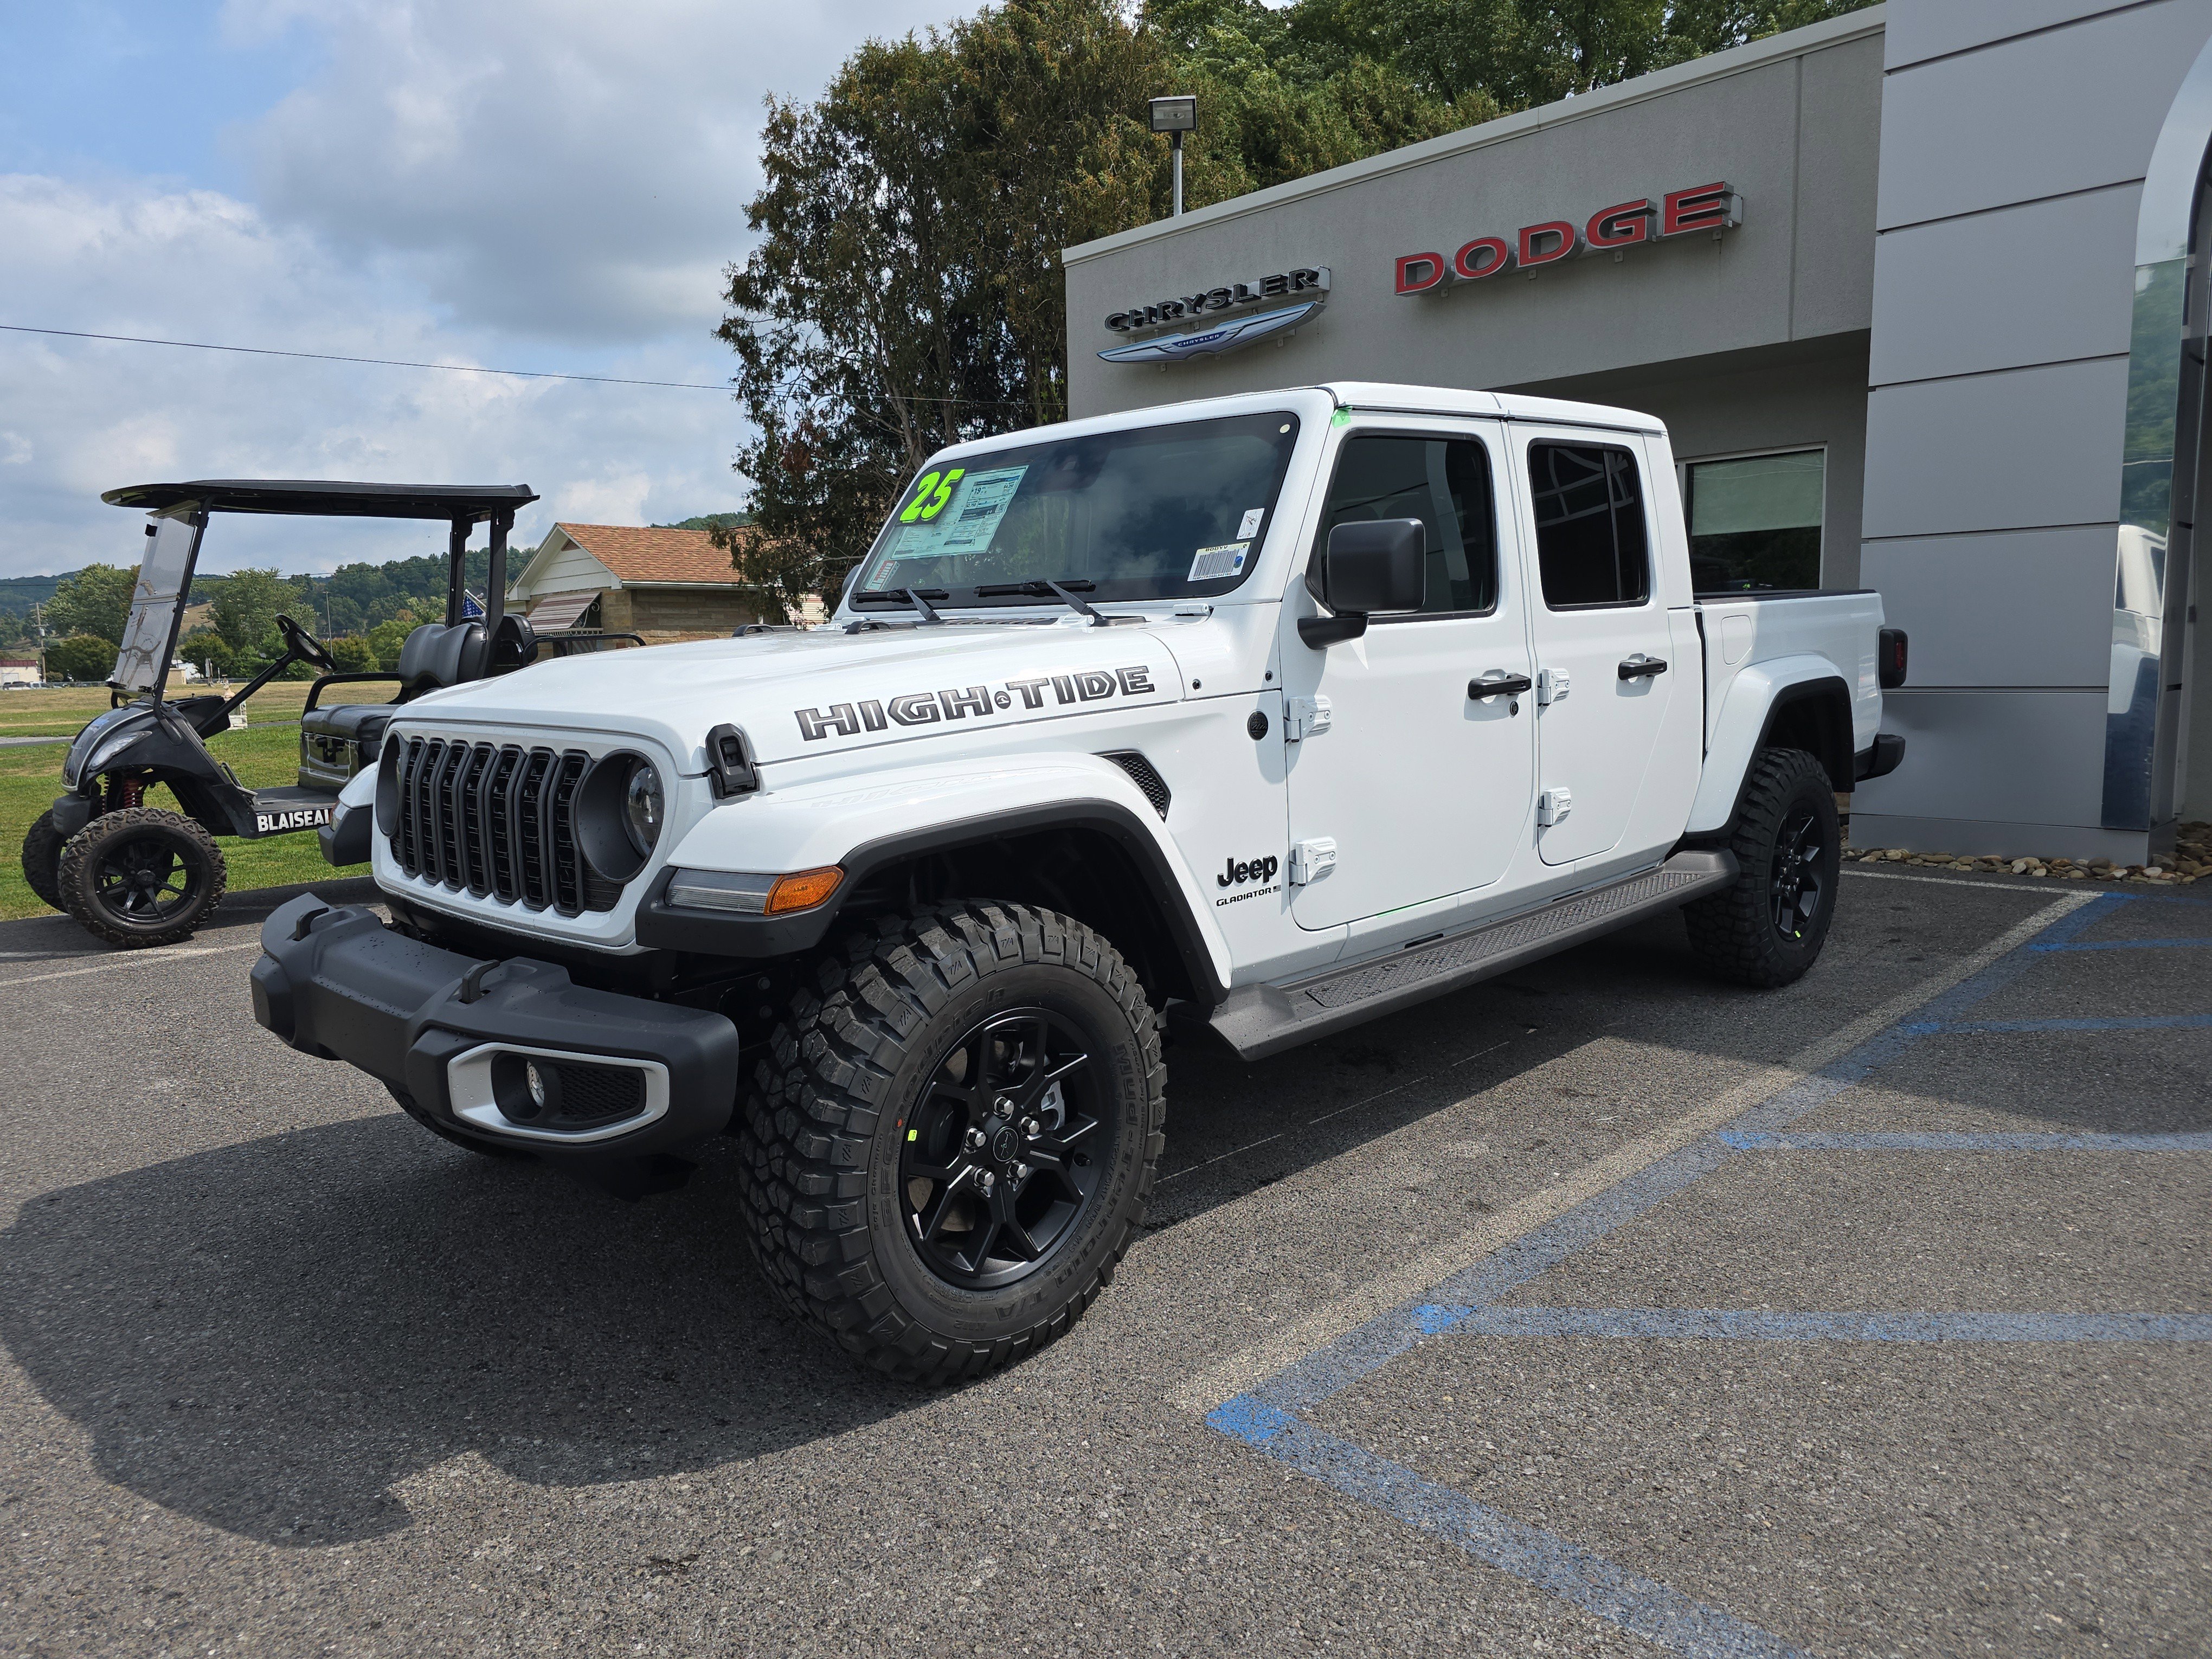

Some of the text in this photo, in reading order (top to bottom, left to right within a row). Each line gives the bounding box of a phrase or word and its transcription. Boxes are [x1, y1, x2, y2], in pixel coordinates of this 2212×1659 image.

[1394, 181, 1732, 298] DODGE
[1104, 268, 1320, 331] CHRYSLER
[1178, 333, 1220, 347] CHRYSLER
[899, 468, 966, 523] 25
[794, 665, 1155, 742] HIGH TIDE
[1216, 887, 1272, 906] GLADIATOR
[1217, 854, 1278, 887] Jeep
